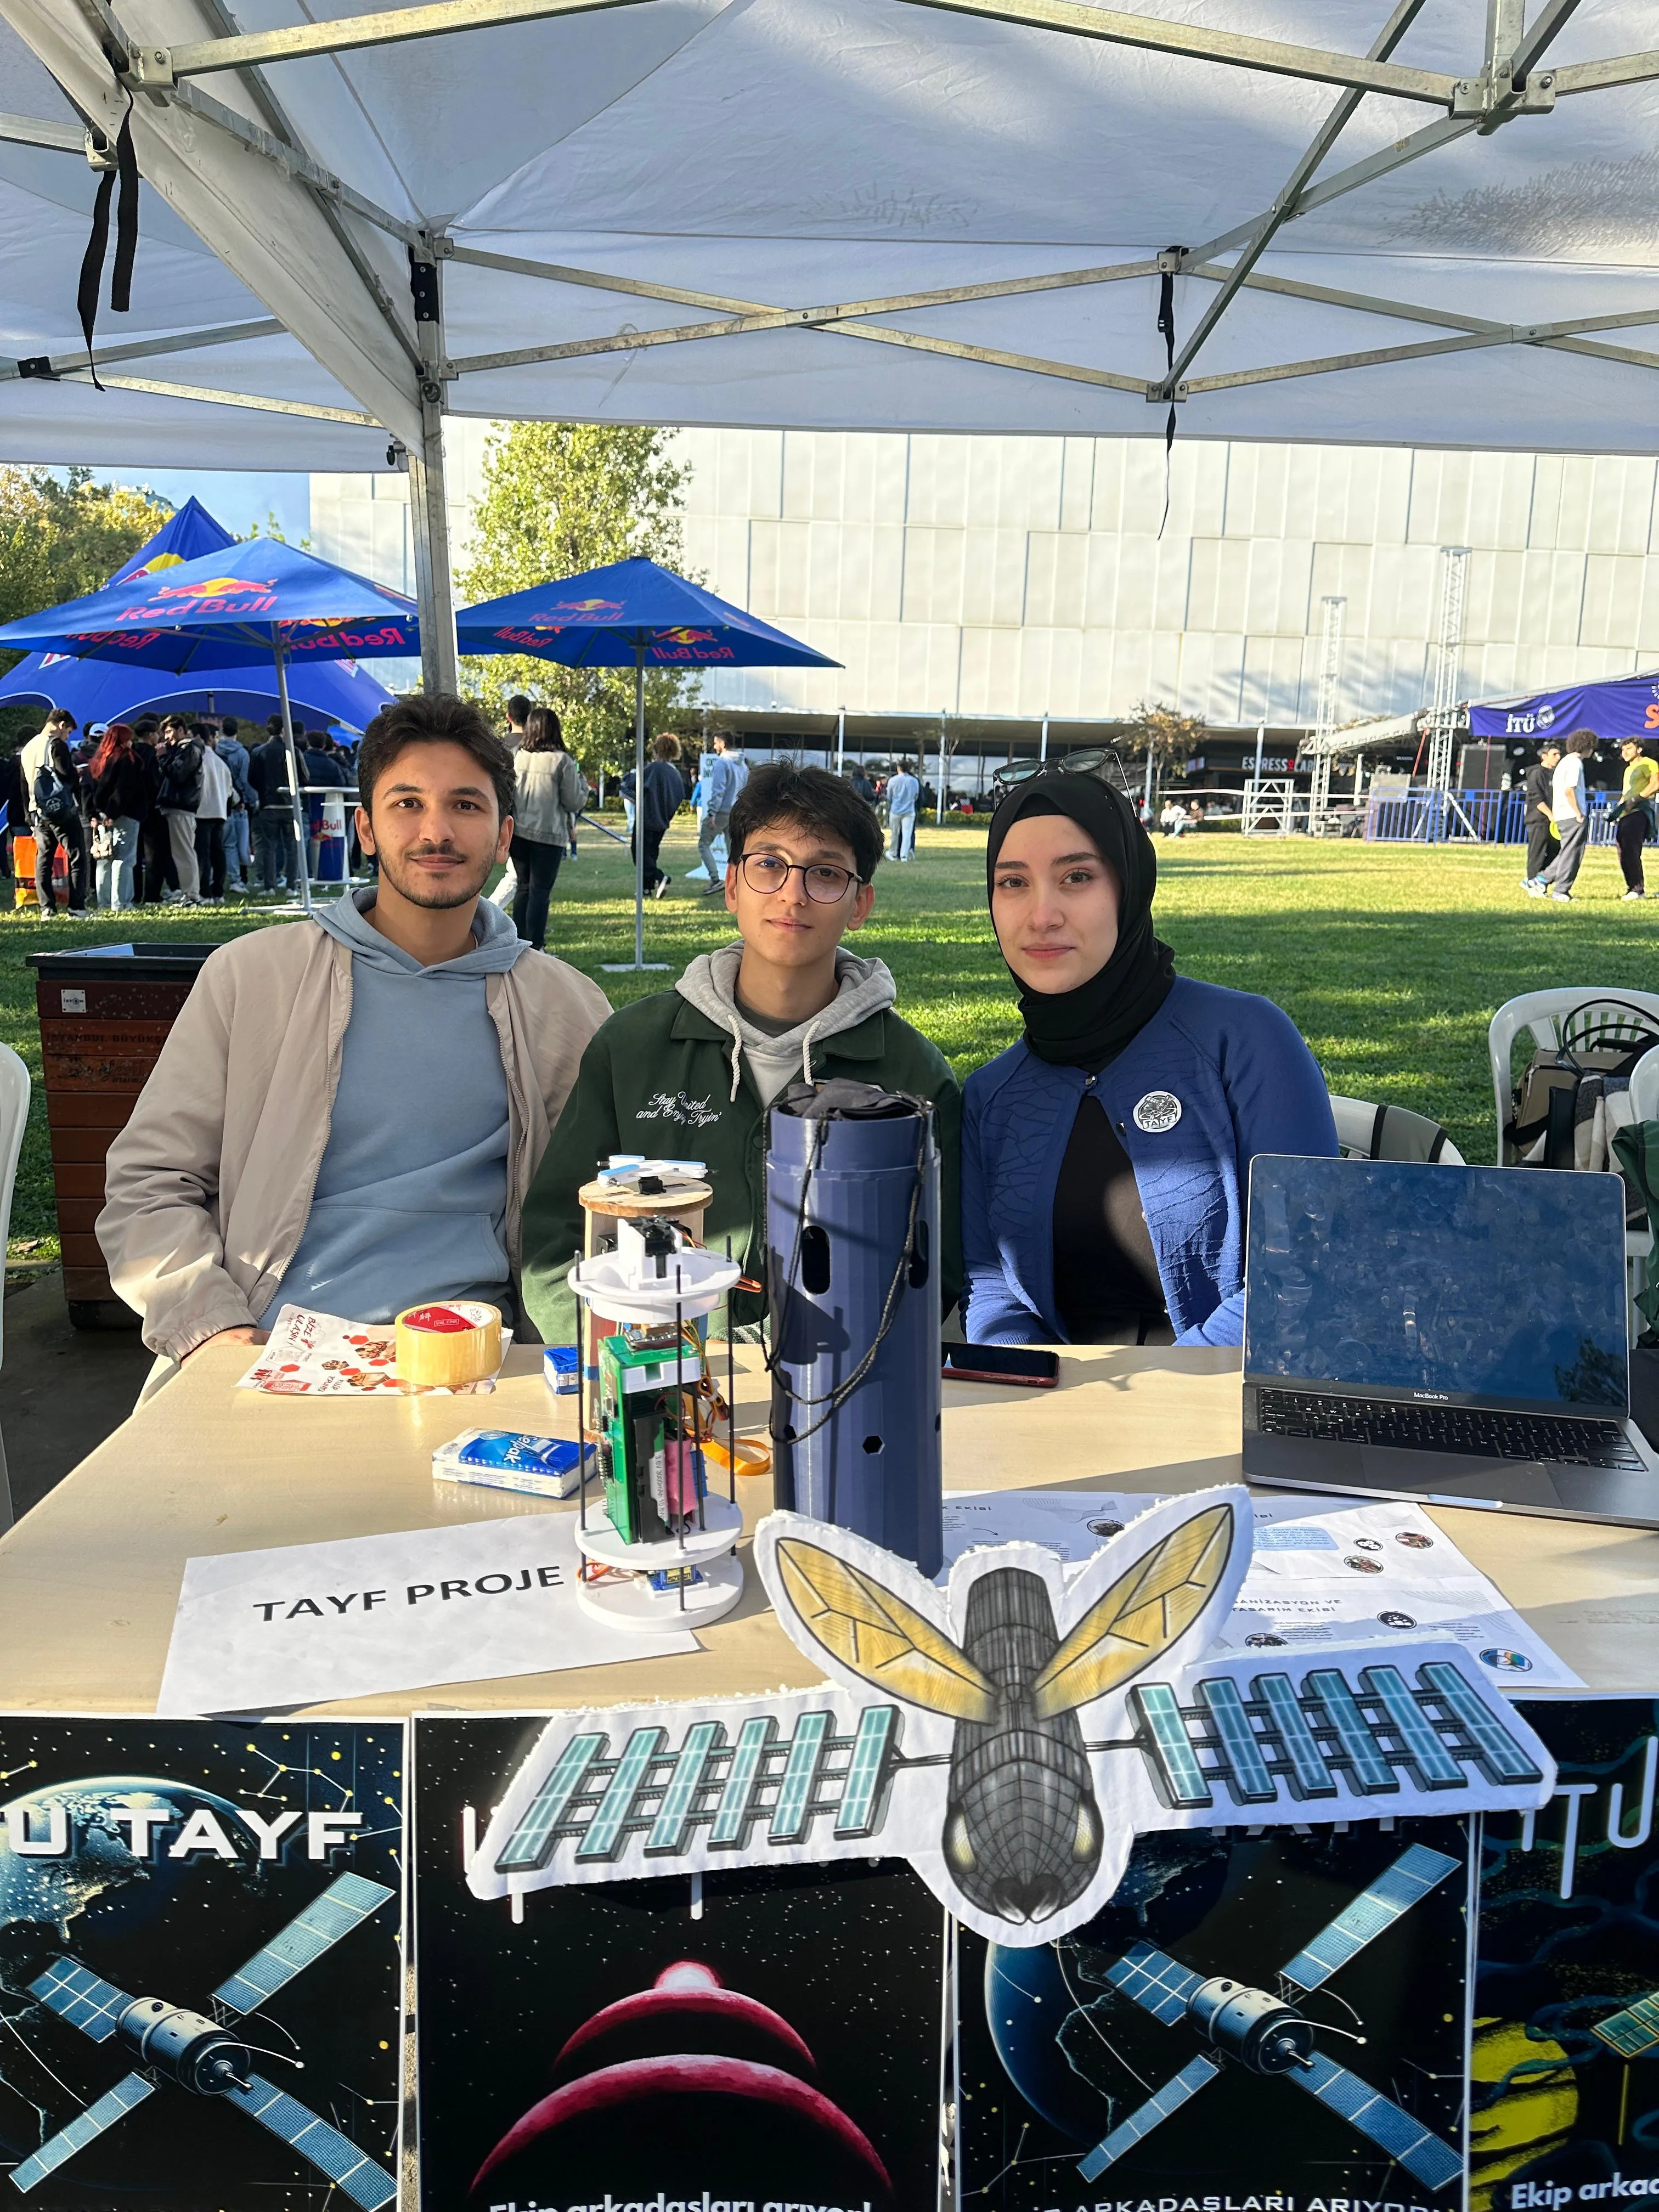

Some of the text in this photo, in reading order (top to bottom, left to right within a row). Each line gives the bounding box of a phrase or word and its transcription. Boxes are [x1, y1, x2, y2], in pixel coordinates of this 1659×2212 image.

[115, 596, 278, 622] Red Bull
[527, 611, 624, 622] Red Bull
[1505, 713, 1536, 733] İTÜ
[322, 819, 342, 831] Bull
[648, 1091, 711, 1110] Stay United
[636, 1105, 663, 1119] and
[1144, 1115, 1173, 1128] TAYF
[503, 1435, 539, 1464] Selpak
[252, 1565, 565, 1622] TAYF PROJE
[110, 1808, 363, 1860] TAYF
[1511, 2180, 1572, 2211] Ekip
